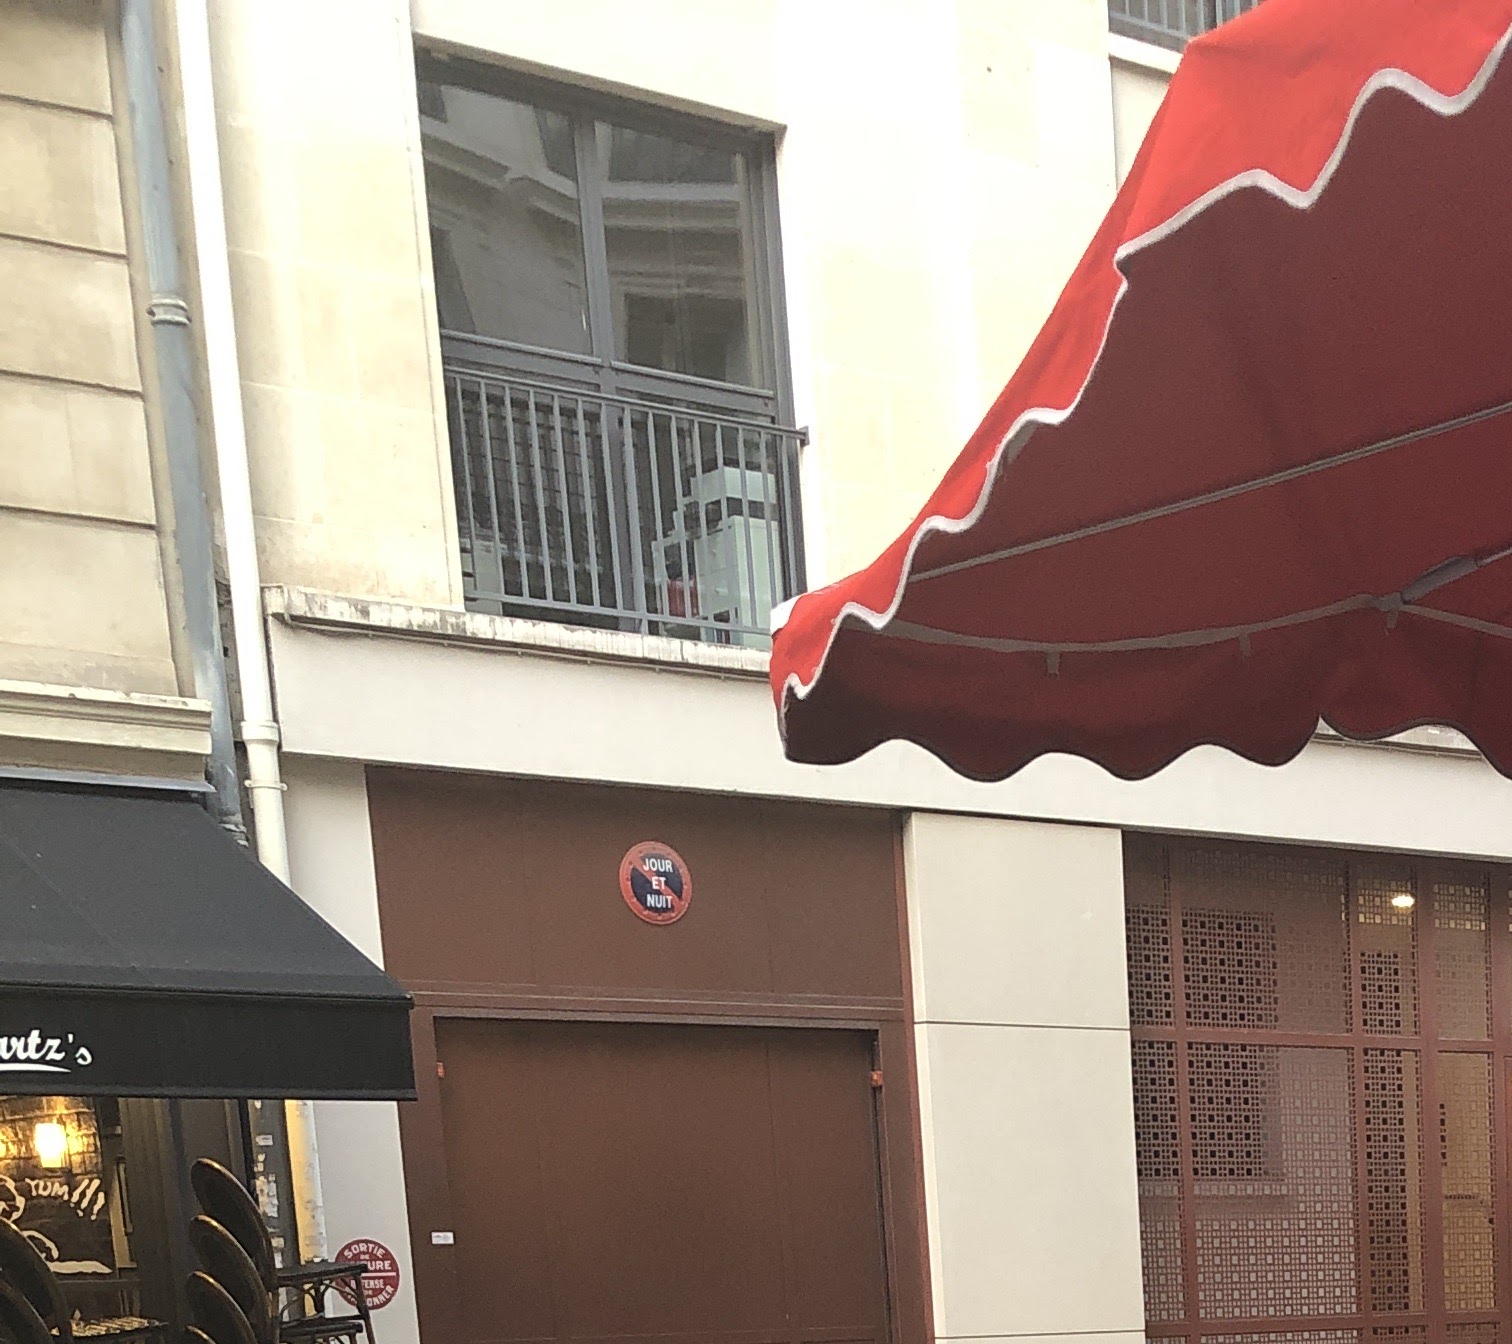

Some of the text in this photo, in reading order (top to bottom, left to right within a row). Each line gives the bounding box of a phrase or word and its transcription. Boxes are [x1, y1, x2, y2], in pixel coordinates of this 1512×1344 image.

[643, 858, 673, 873] JOUR
[651, 876, 667, 890] ET
[646, 893, 673, 908] NUIT
[343, 1242, 386, 1259] SORTIE
